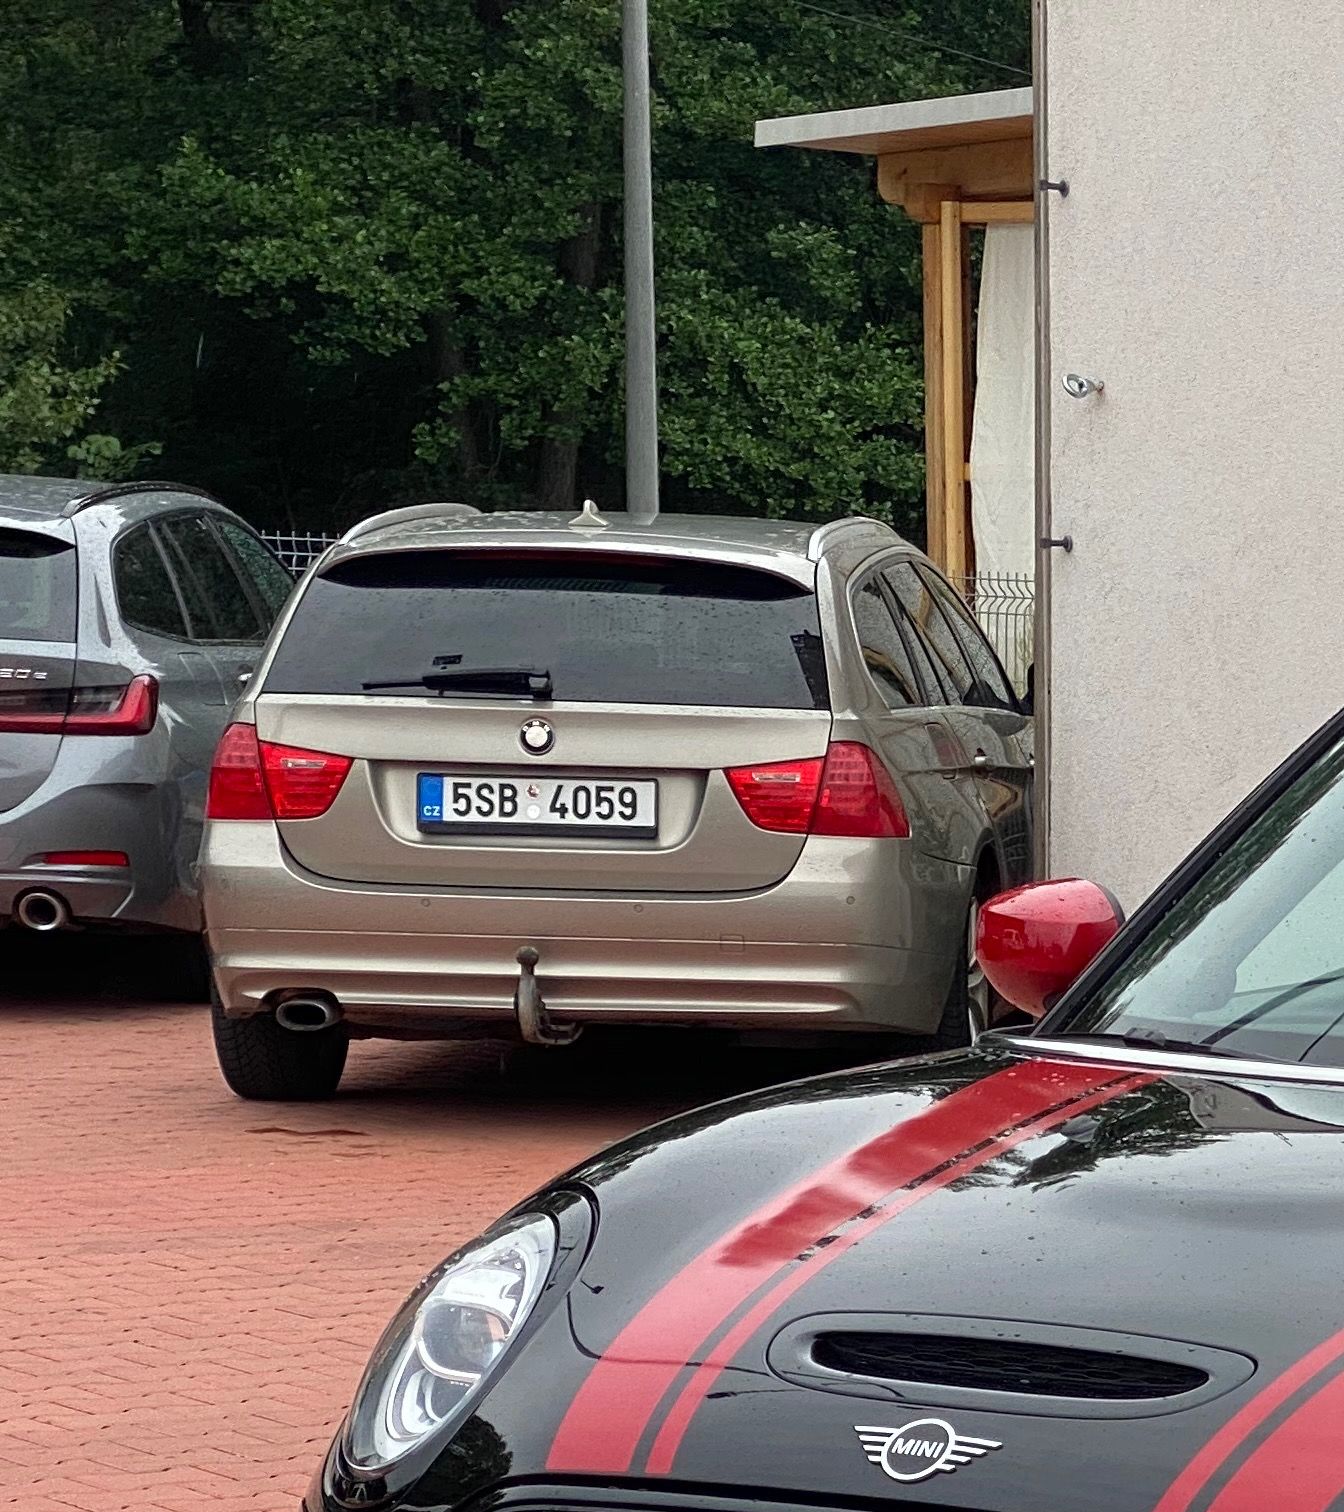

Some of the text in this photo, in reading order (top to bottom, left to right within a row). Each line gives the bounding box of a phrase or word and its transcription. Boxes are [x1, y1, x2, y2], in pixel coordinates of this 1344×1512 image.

[423, 805, 441, 816] CZ
[452, 782, 638, 821] 5SB 4059
[891, 1437, 945, 1459] MINI
